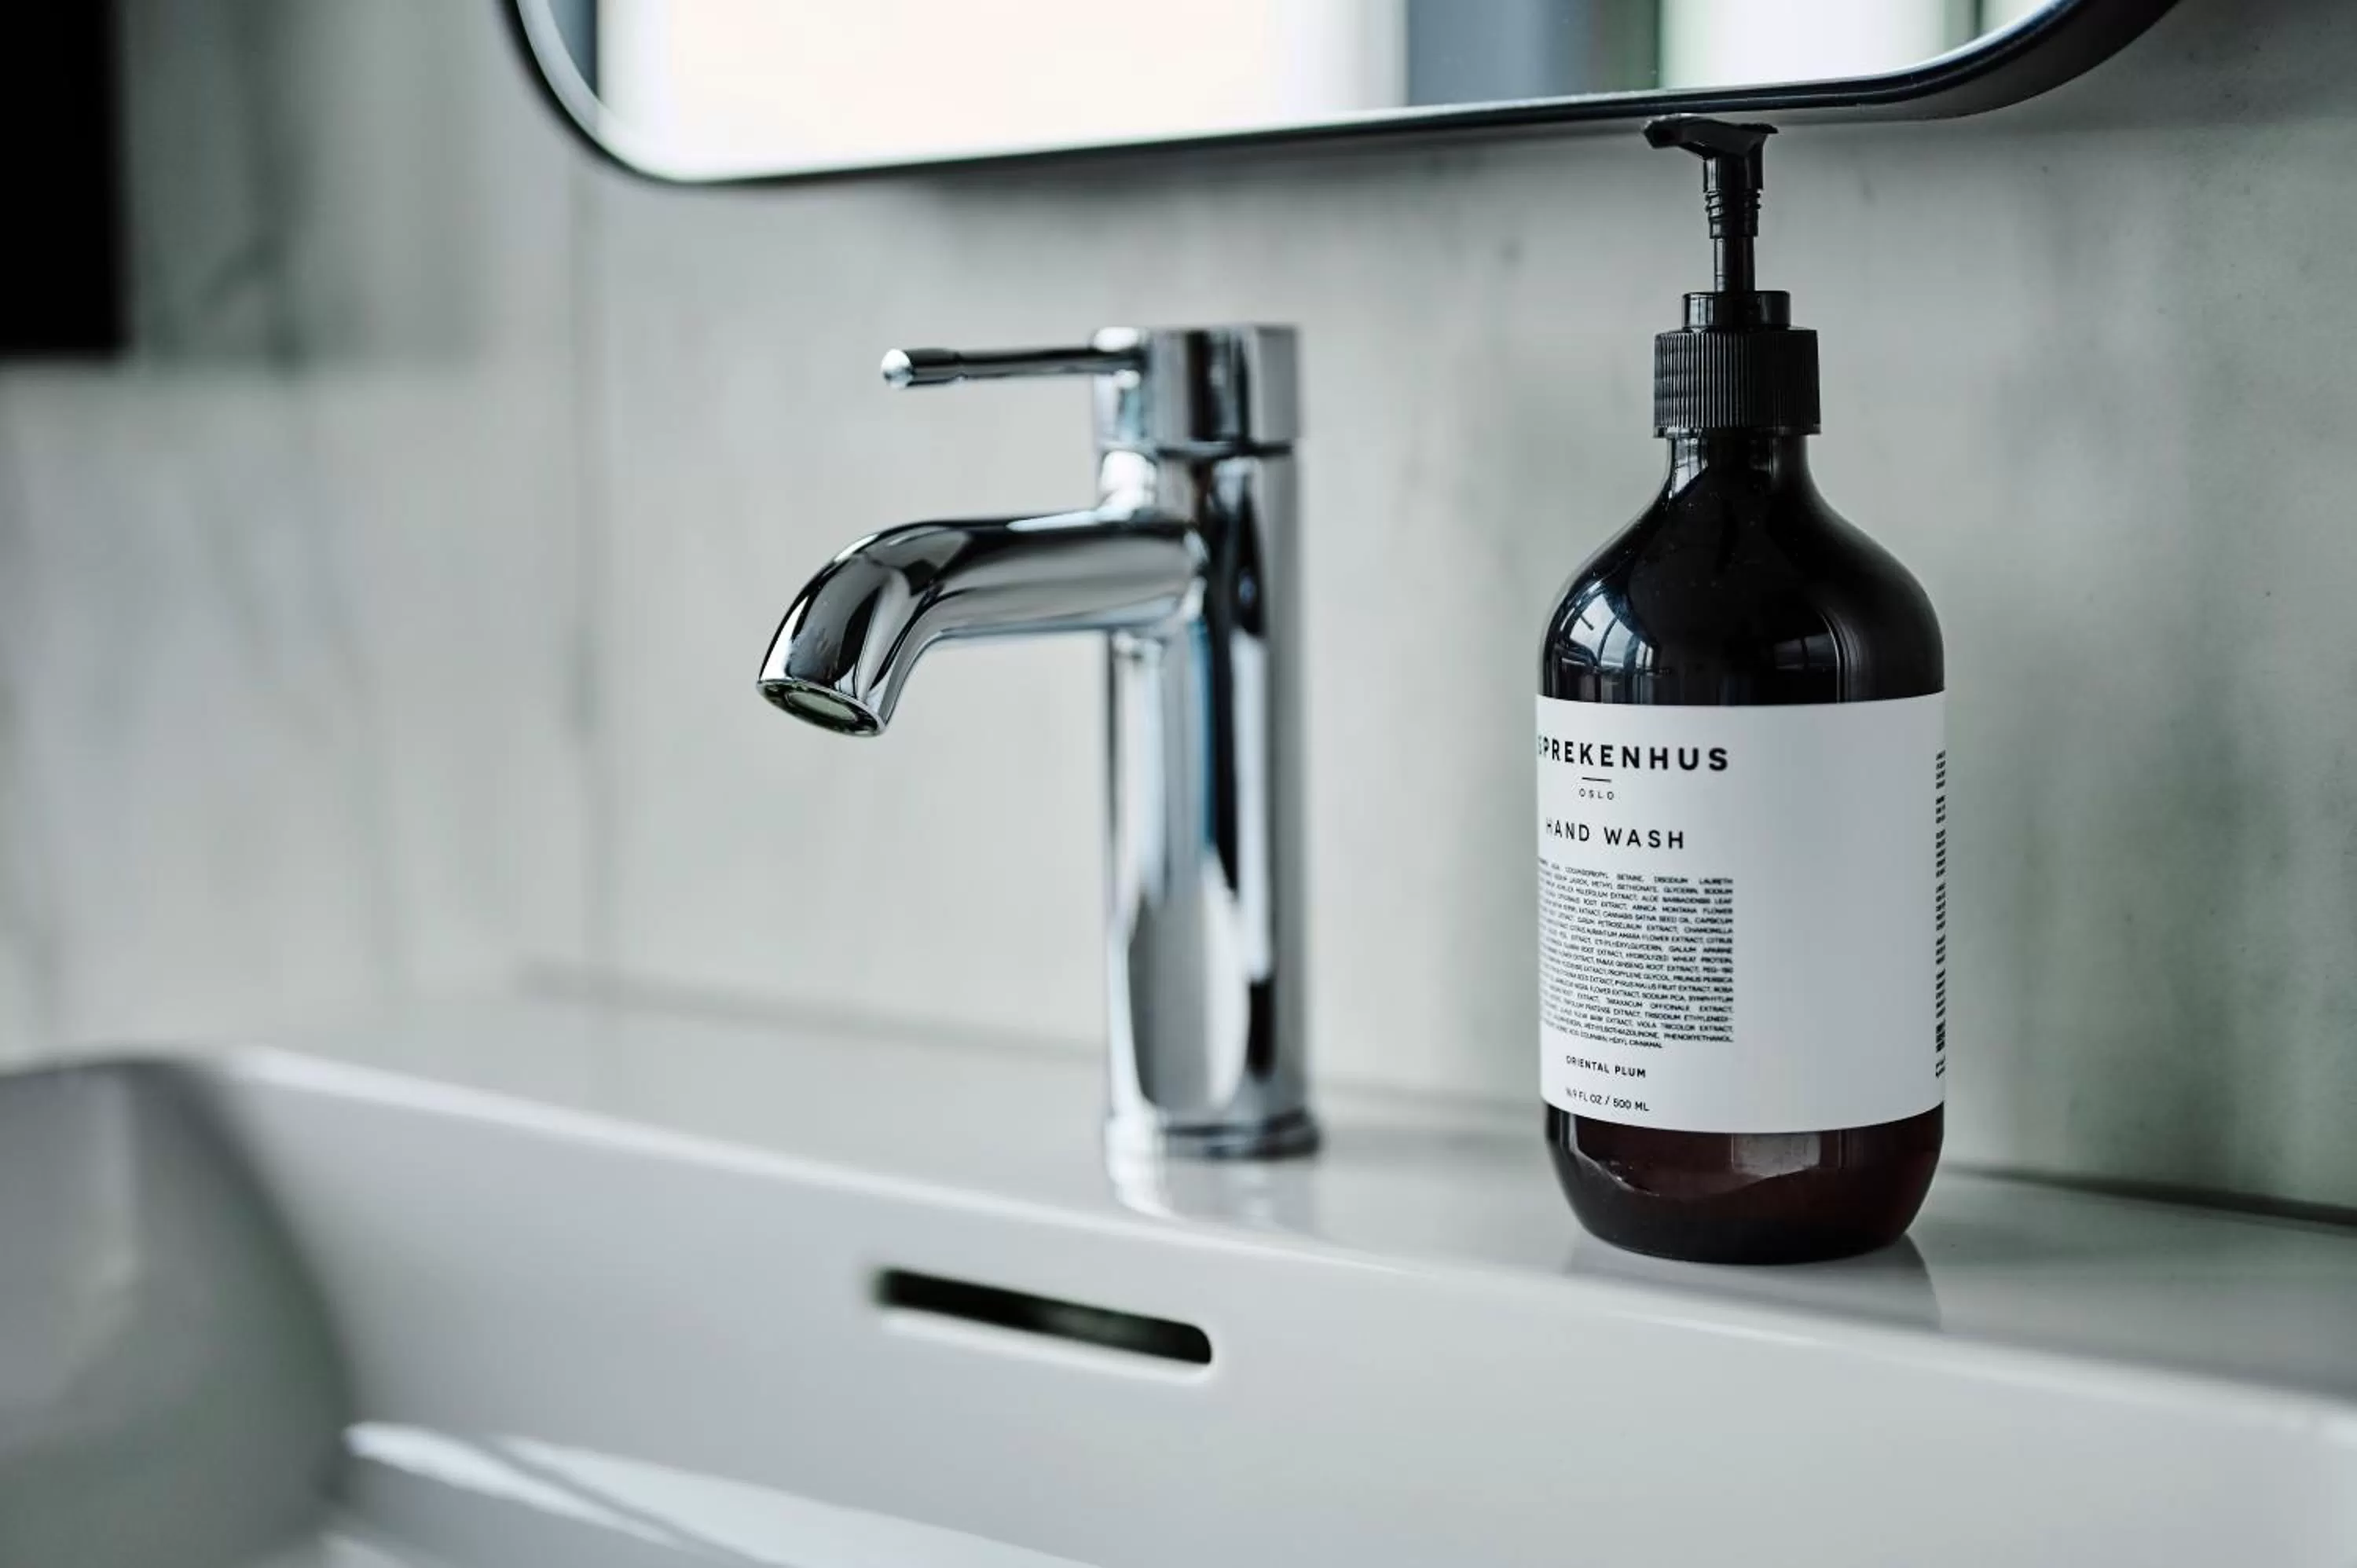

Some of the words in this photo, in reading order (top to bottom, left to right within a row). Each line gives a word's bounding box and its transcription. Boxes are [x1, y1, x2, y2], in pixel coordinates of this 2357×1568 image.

[1538, 735, 1728, 771] SPREKENHUS
[1579, 788, 1615, 800] OSLO
[1546, 817, 1589, 842] HAND
[1604, 826, 1683, 849] WASH
[1566, 1055, 1610, 1074] ORIENTAL
[1615, 1064, 1646, 1079] PLUM
[1578, 1091, 1588, 1102] FL
[1589, 1094, 1602, 1105] OZ
[1604, 1094, 1611, 1106] /
[1613, 1097, 1631, 1110] 500
[1635, 1101, 1650, 1112] ML
